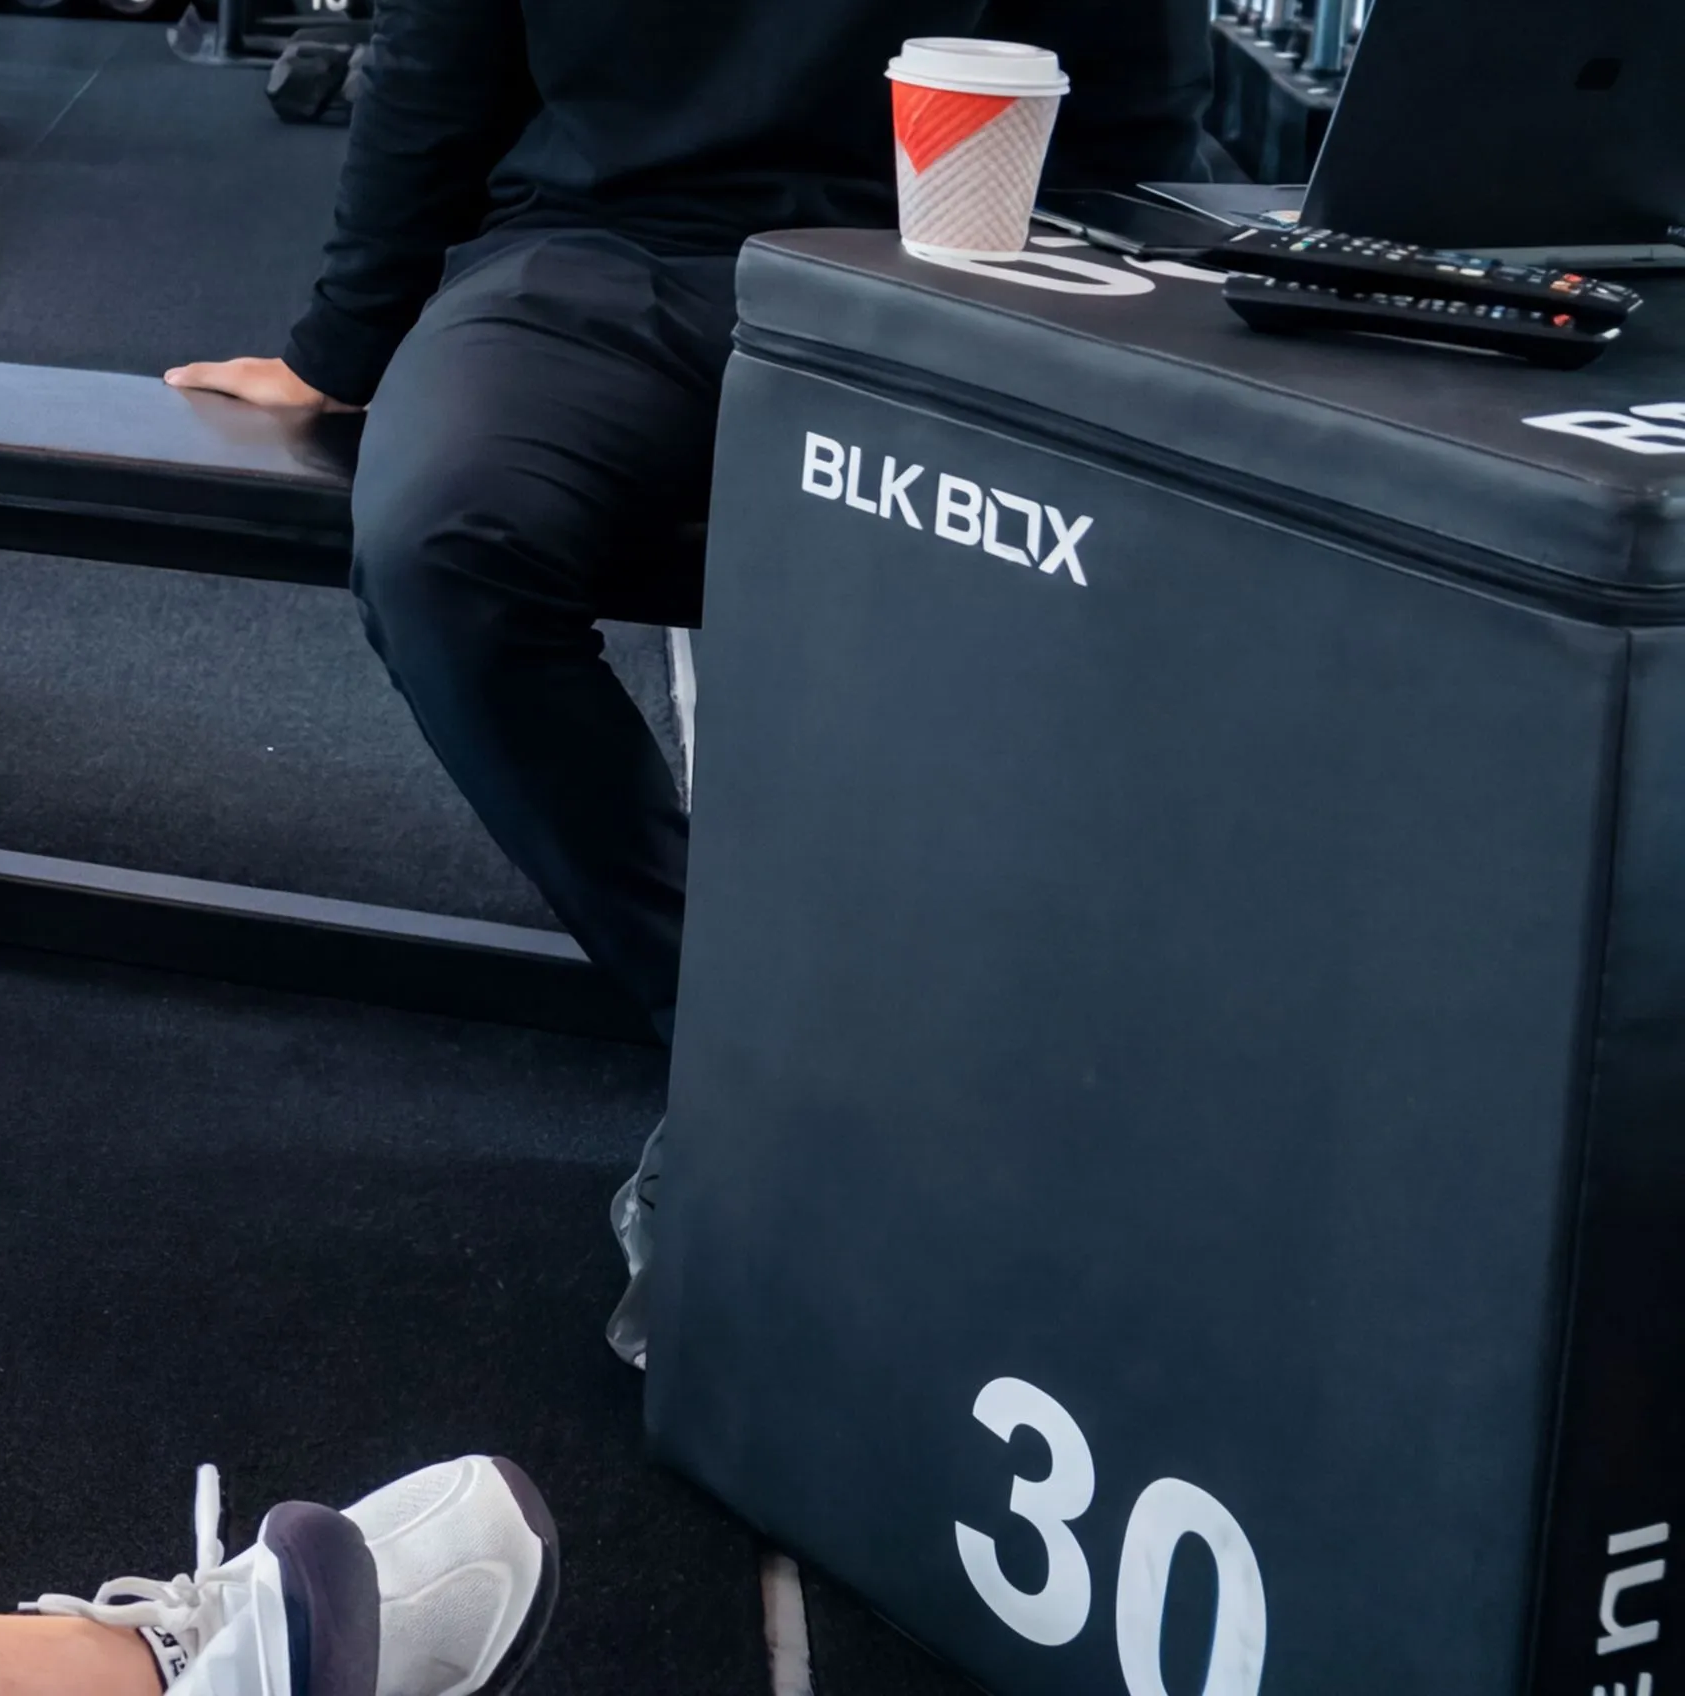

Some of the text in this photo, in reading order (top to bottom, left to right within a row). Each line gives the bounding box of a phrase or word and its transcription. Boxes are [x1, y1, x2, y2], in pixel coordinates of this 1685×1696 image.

[801, 430, 1095, 587] BLK BOX
[954, 1375, 1269, 1696] 30
